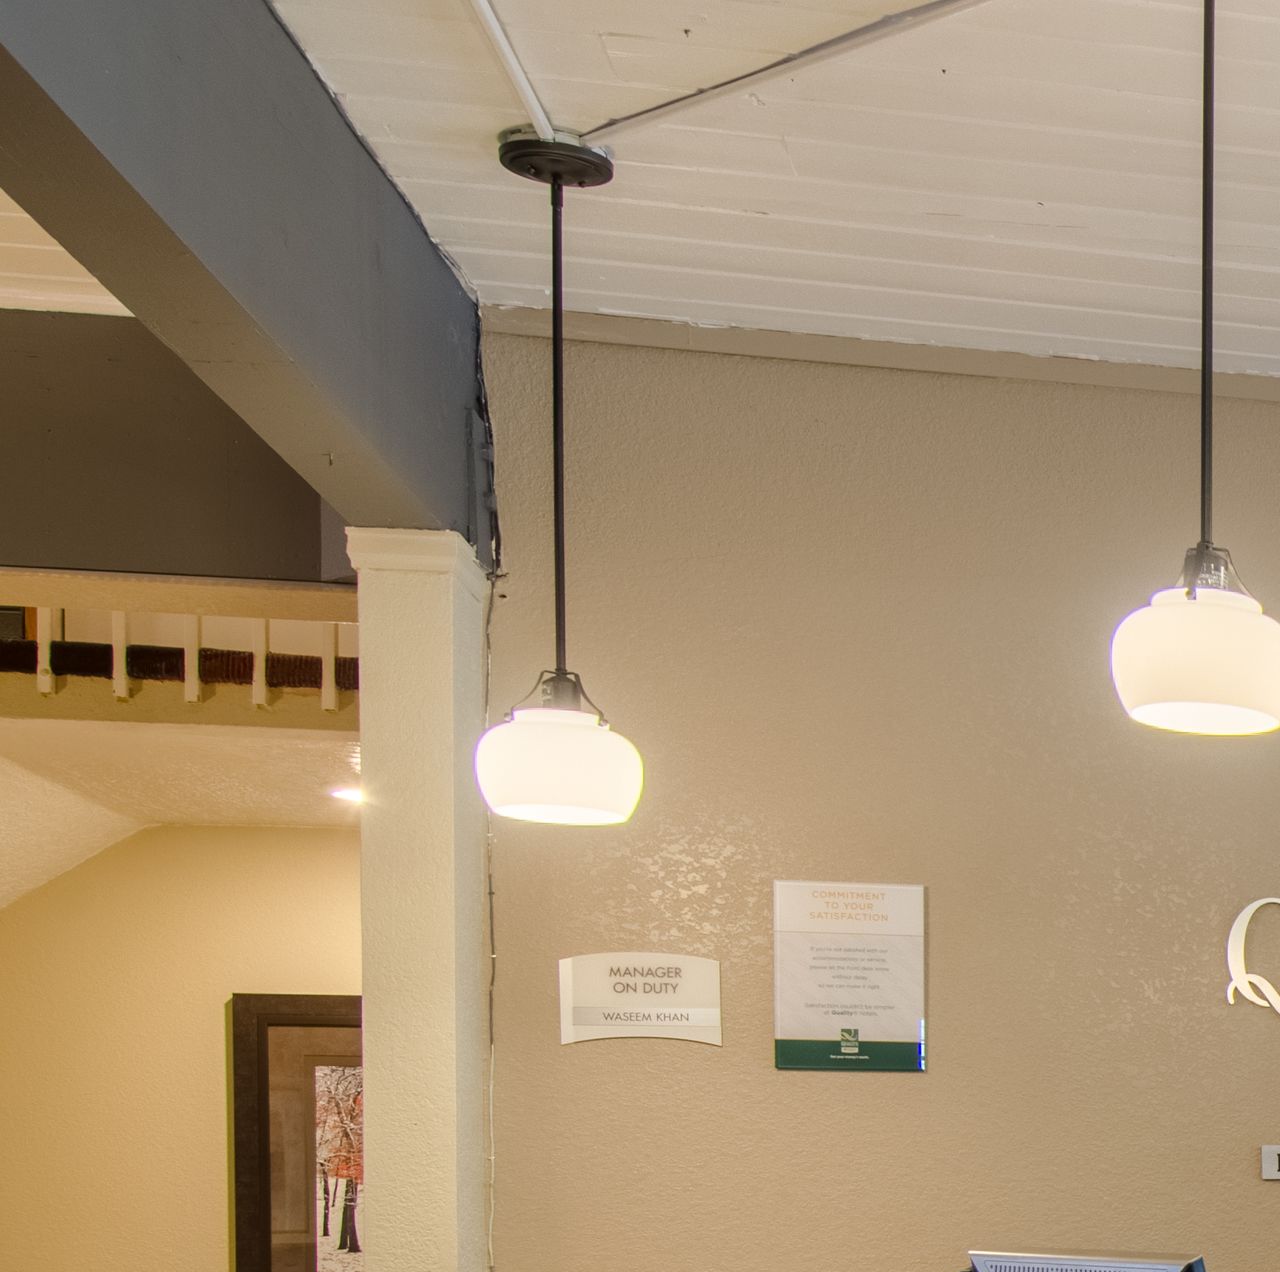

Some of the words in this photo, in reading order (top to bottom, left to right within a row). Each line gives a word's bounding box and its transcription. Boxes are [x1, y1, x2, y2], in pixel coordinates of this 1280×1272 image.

[811, 890, 886, 900] COMMITMENT
[824, 901, 839, 910] TO
[844, 902, 874, 911] YOUR
[809, 911, 889, 922] SATISFACTION
[609, 966, 683, 979] MANAGER
[613, 982, 637, 994] ON
[643, 983, 679, 994] DUTY
[602, 1011, 652, 1022] WASEEM
[656, 1012, 690, 1022] KHAN
